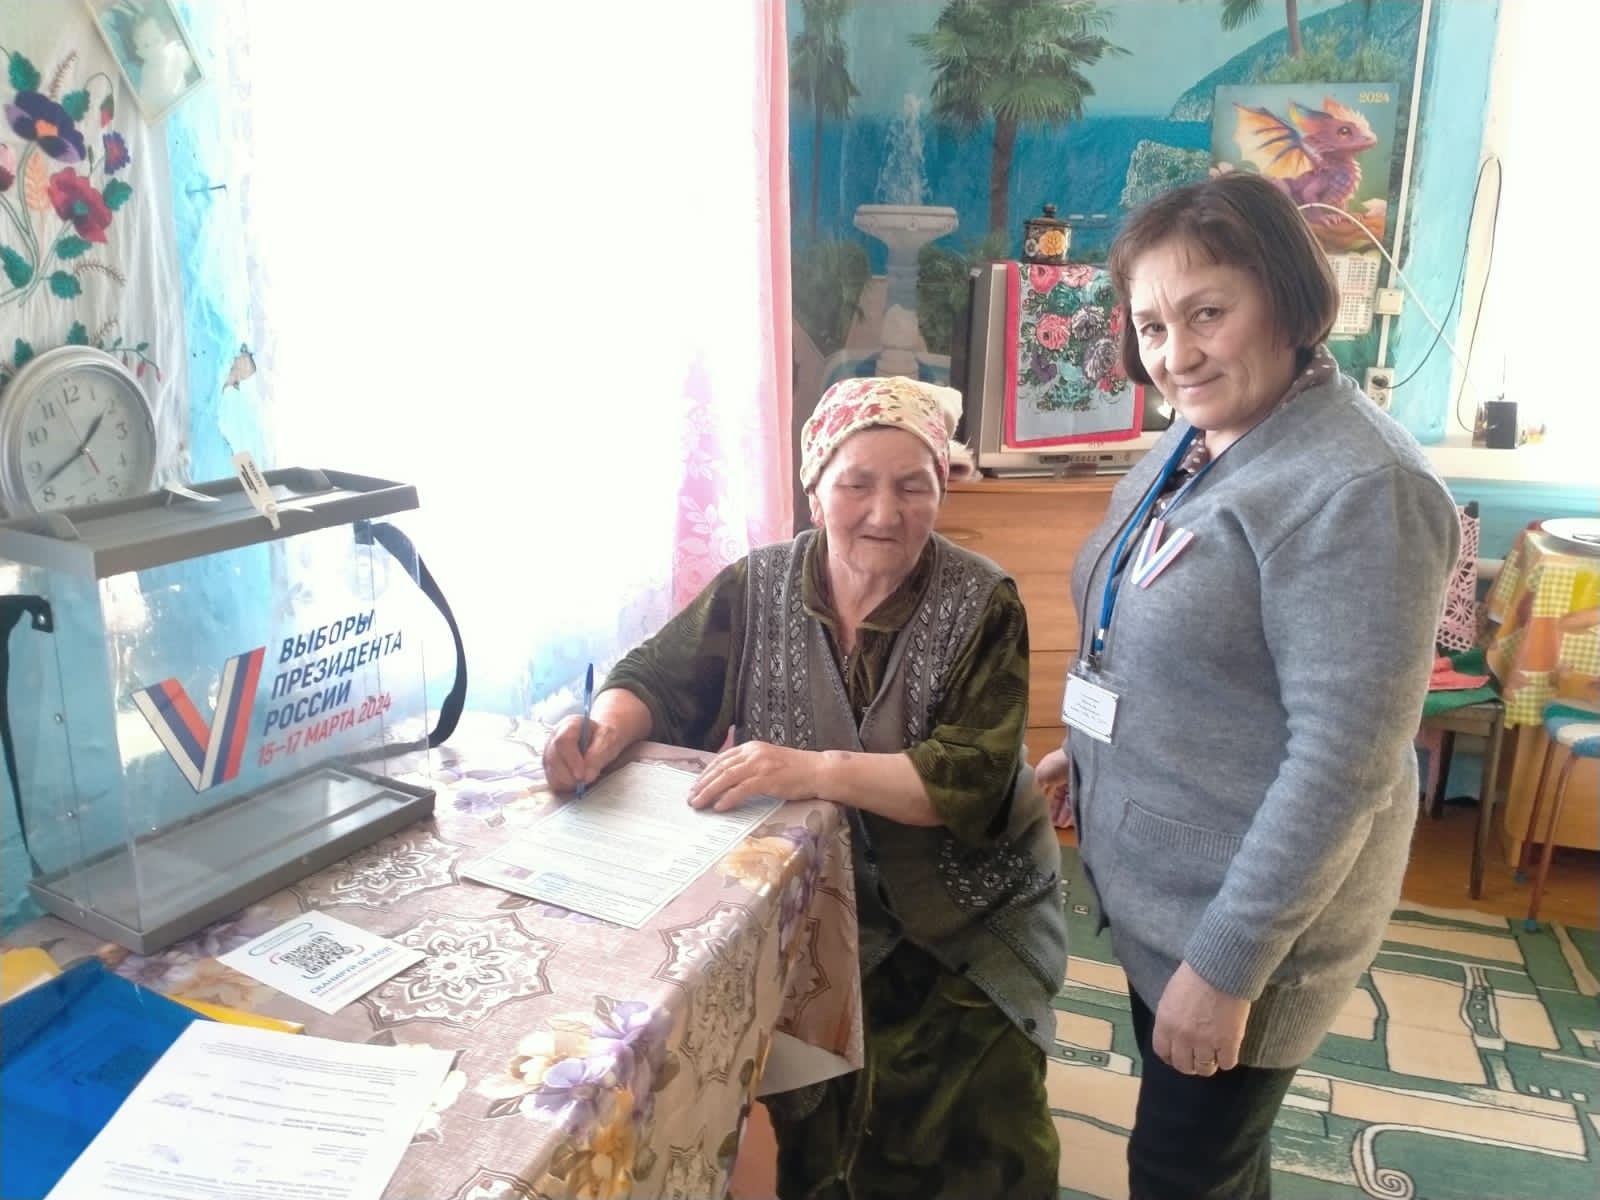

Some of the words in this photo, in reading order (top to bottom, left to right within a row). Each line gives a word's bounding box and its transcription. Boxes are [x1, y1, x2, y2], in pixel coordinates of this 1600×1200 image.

[1359, 92, 1390, 104] 2024
[63, 384, 80, 405] 12
[27, 426, 49, 448] 10
[115, 421, 129, 441] 3
[279, 608, 375, 664] ВЫБОРЫ
[272, 630, 403, 700] ПРЕЗИДЕНТА
[263, 679, 352, 737] РОССИИ
[304, 709, 355, 748] МАРТА
[358, 692, 392, 723] 2024
